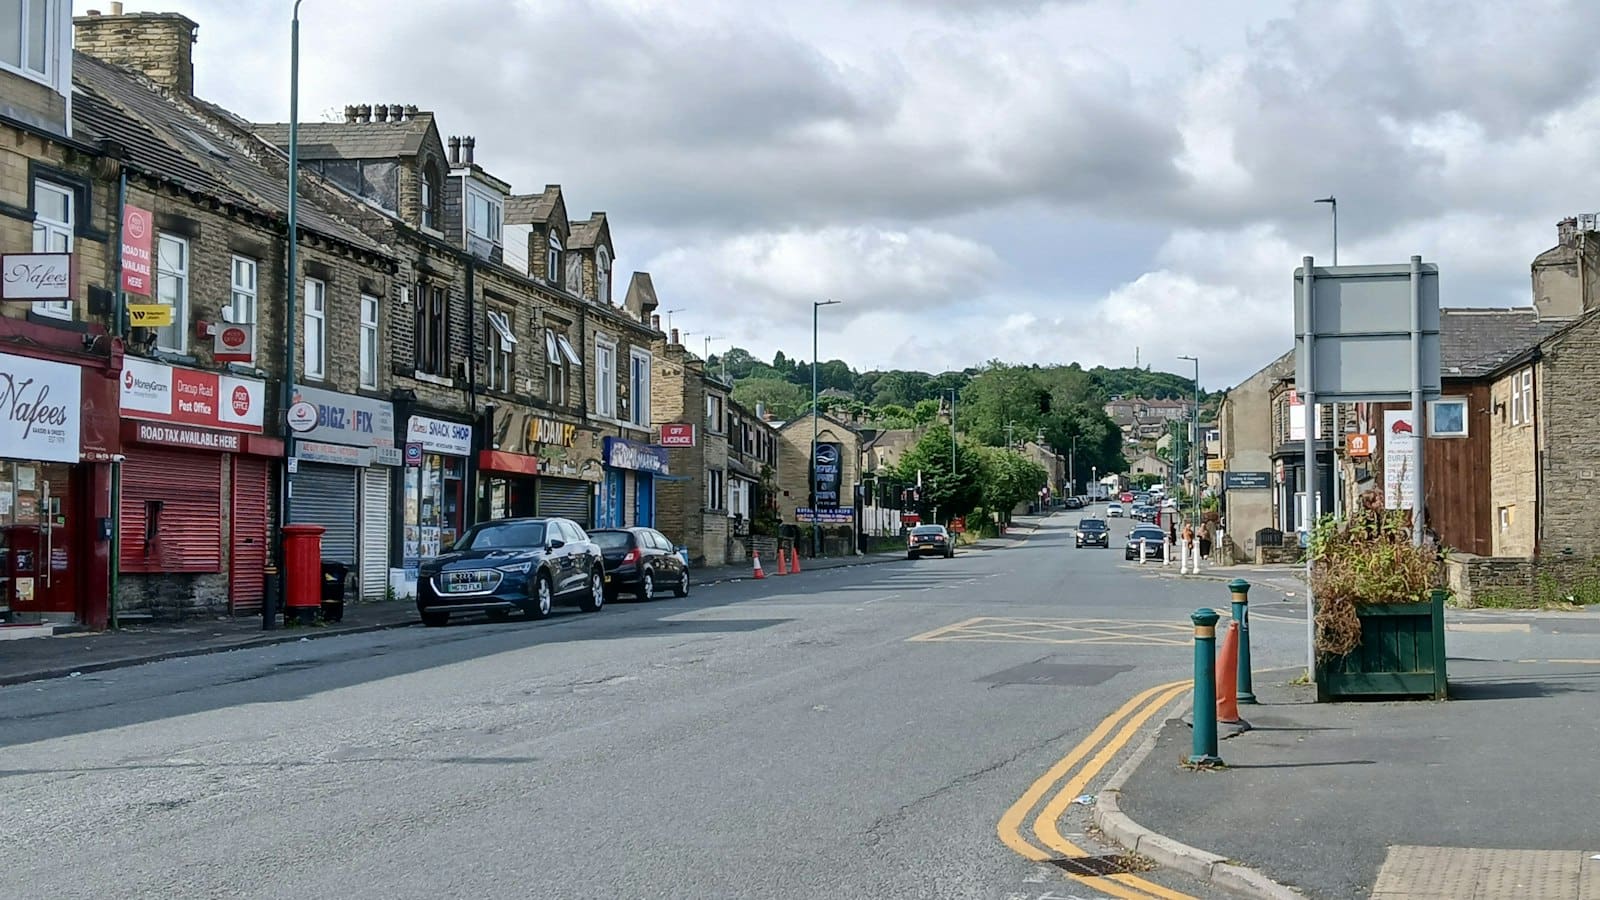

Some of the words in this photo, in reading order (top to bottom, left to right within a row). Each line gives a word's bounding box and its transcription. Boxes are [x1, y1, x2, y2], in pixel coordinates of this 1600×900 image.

[4, 264, 67, 289] Nafees
[127, 275, 143, 288] HERE
[199, 383, 213, 397] Road
[235, 391, 248, 401] POST
[0, 372, 67, 440] Nafees
[178, 400, 193, 412] Post
[193, 401, 212, 414] Office
[233, 400, 249, 411] OFFICE
[319, 404, 345, 430] BIGZ
[141, 425, 164, 440] ROAD
[164, 428, 179, 442] TAX
[180, 430, 218, 446] AVAILABLE
[219, 435, 237, 449] HERE
[429, 421, 450, 438] SNACK
[452, 425, 469, 441] SHOP
[537, 418, 563, 446] ADAM
[670, 427, 684, 435] OFF
[663, 436, 690, 444] LICENCE
